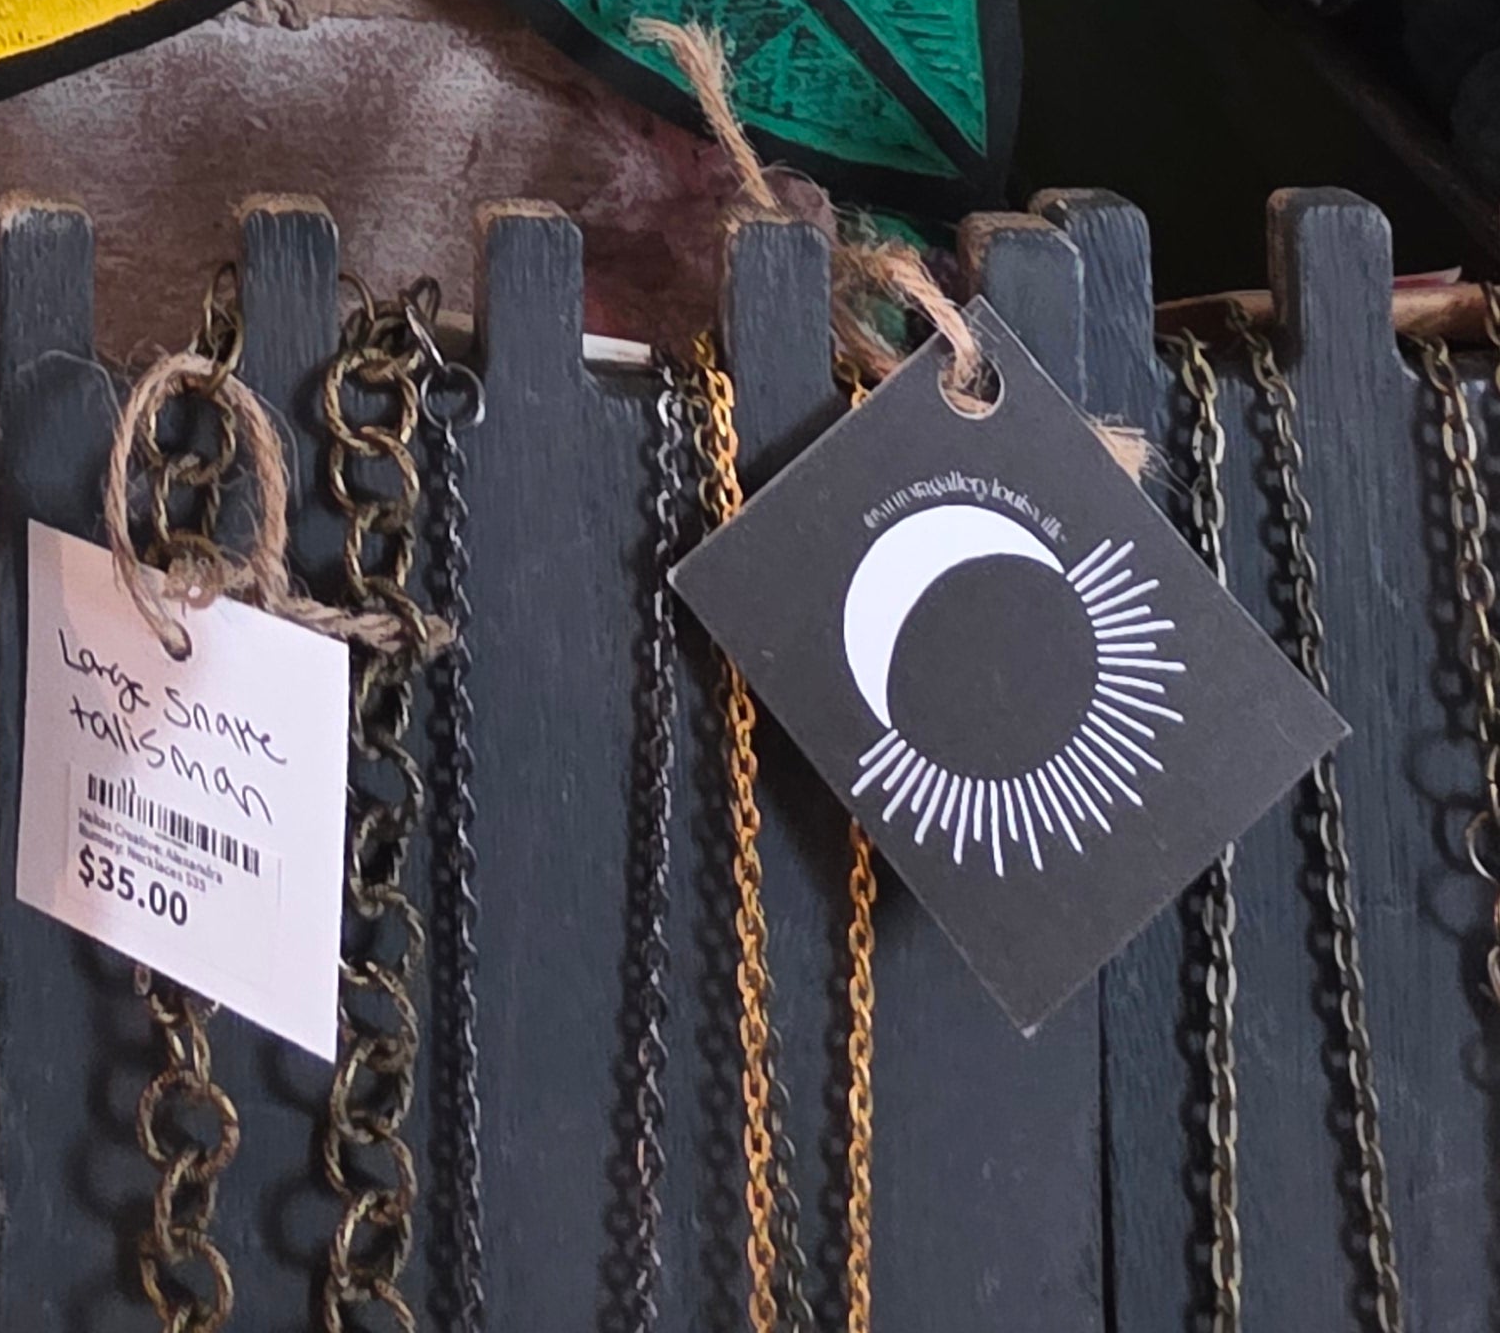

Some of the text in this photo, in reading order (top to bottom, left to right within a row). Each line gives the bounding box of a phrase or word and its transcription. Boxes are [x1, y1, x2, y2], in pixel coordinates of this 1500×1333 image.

[58, 628, 150, 711] Large
[70, 696, 273, 825] talisman
[77, 844, 188, 926] $35.00
